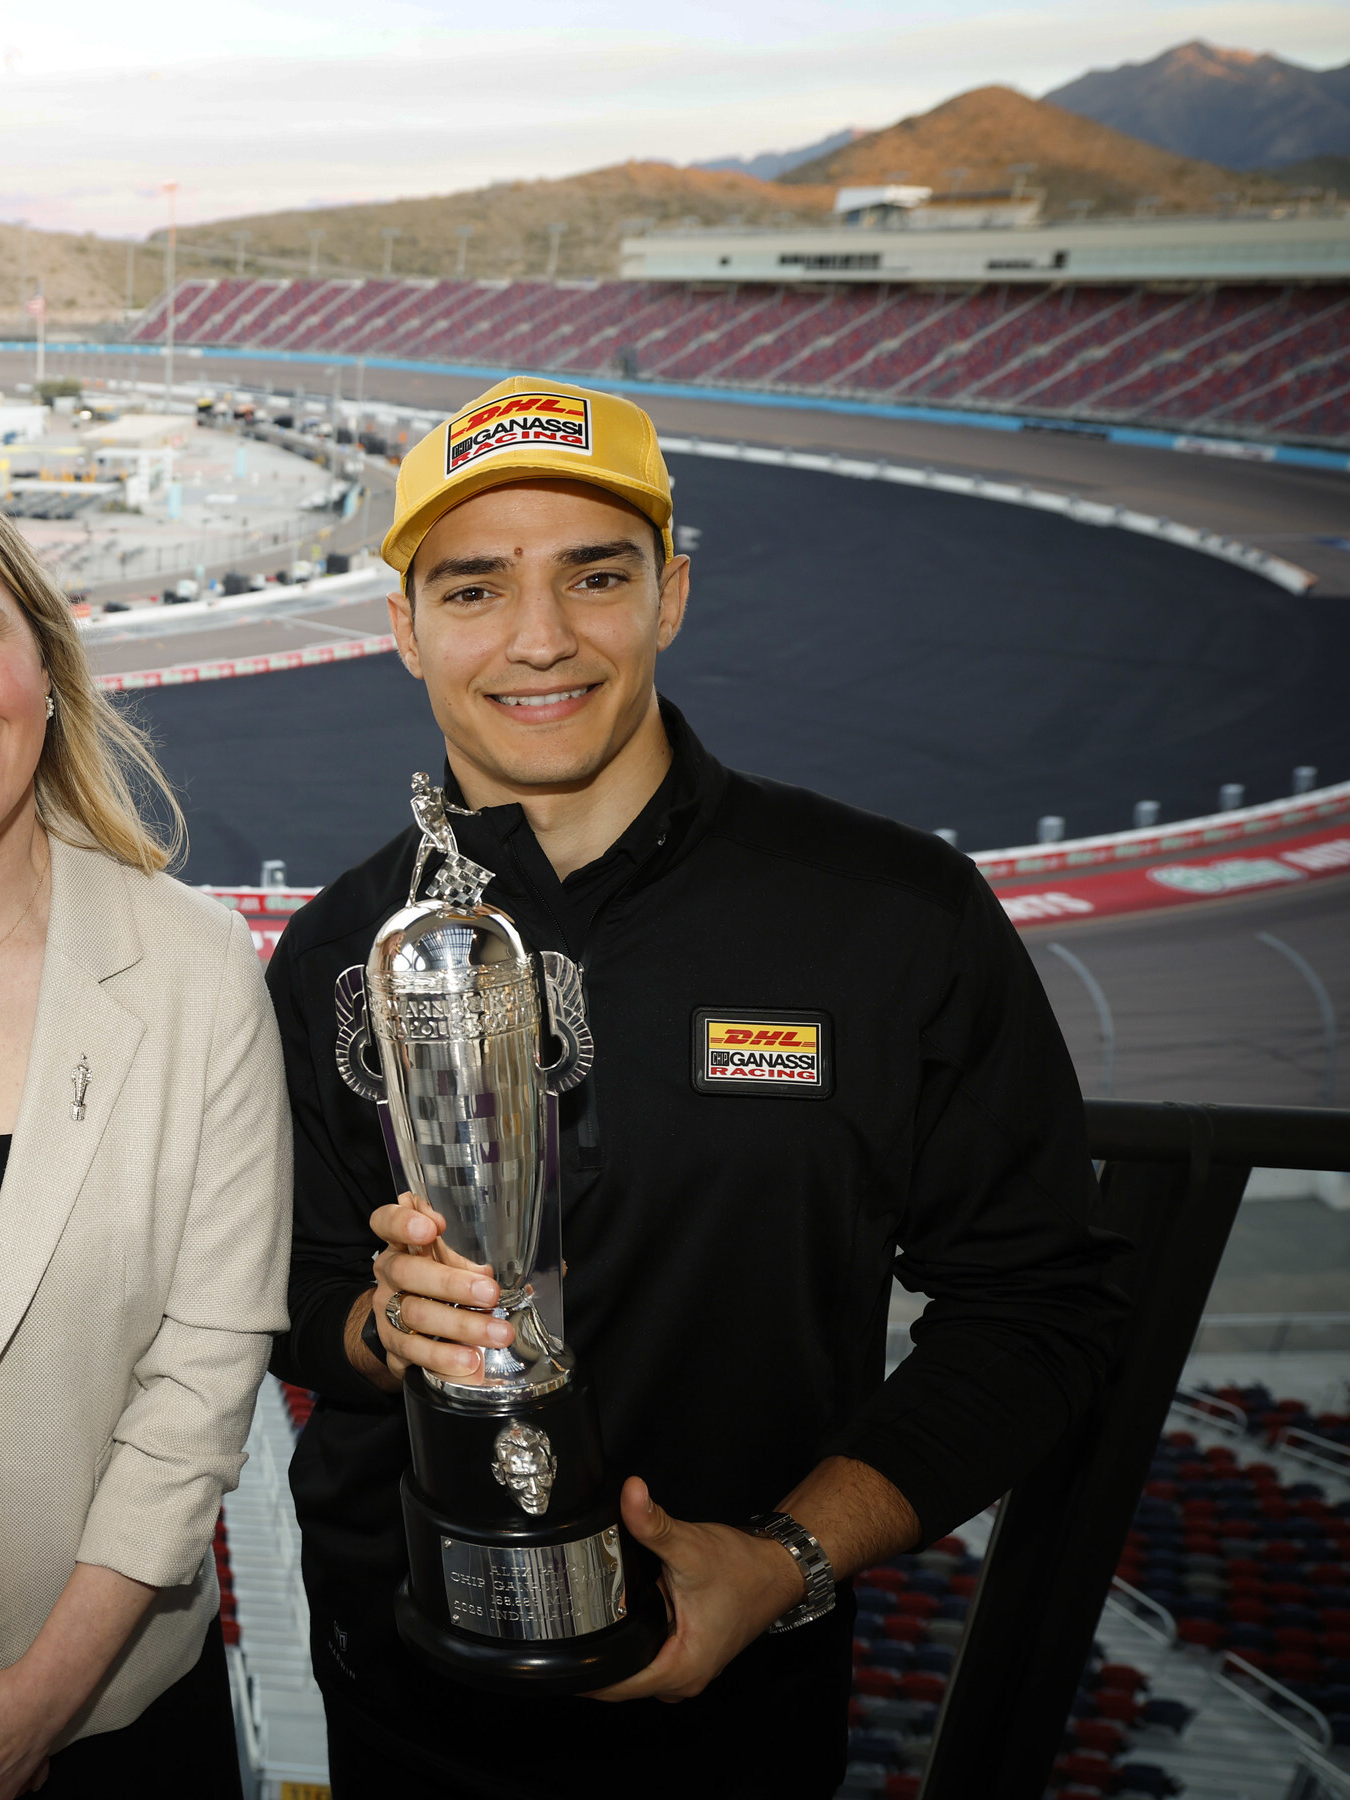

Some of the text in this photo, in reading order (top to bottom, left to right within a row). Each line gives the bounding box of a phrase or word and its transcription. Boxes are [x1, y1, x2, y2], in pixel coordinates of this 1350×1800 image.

[466, 398, 568, 432] DHL
[473, 417, 583, 446] GANASSI
[451, 430, 583, 468] RACING
[723, 1028, 803, 1047] DHL
[711, 1051, 815, 1070] CHIP GANASSI
[711, 1067, 815, 1080] RACING
[451, 1571, 486, 1588] CHIP
[489, 1565, 532, 1577] ALEX
[454, 1599, 483, 1617] 2025
